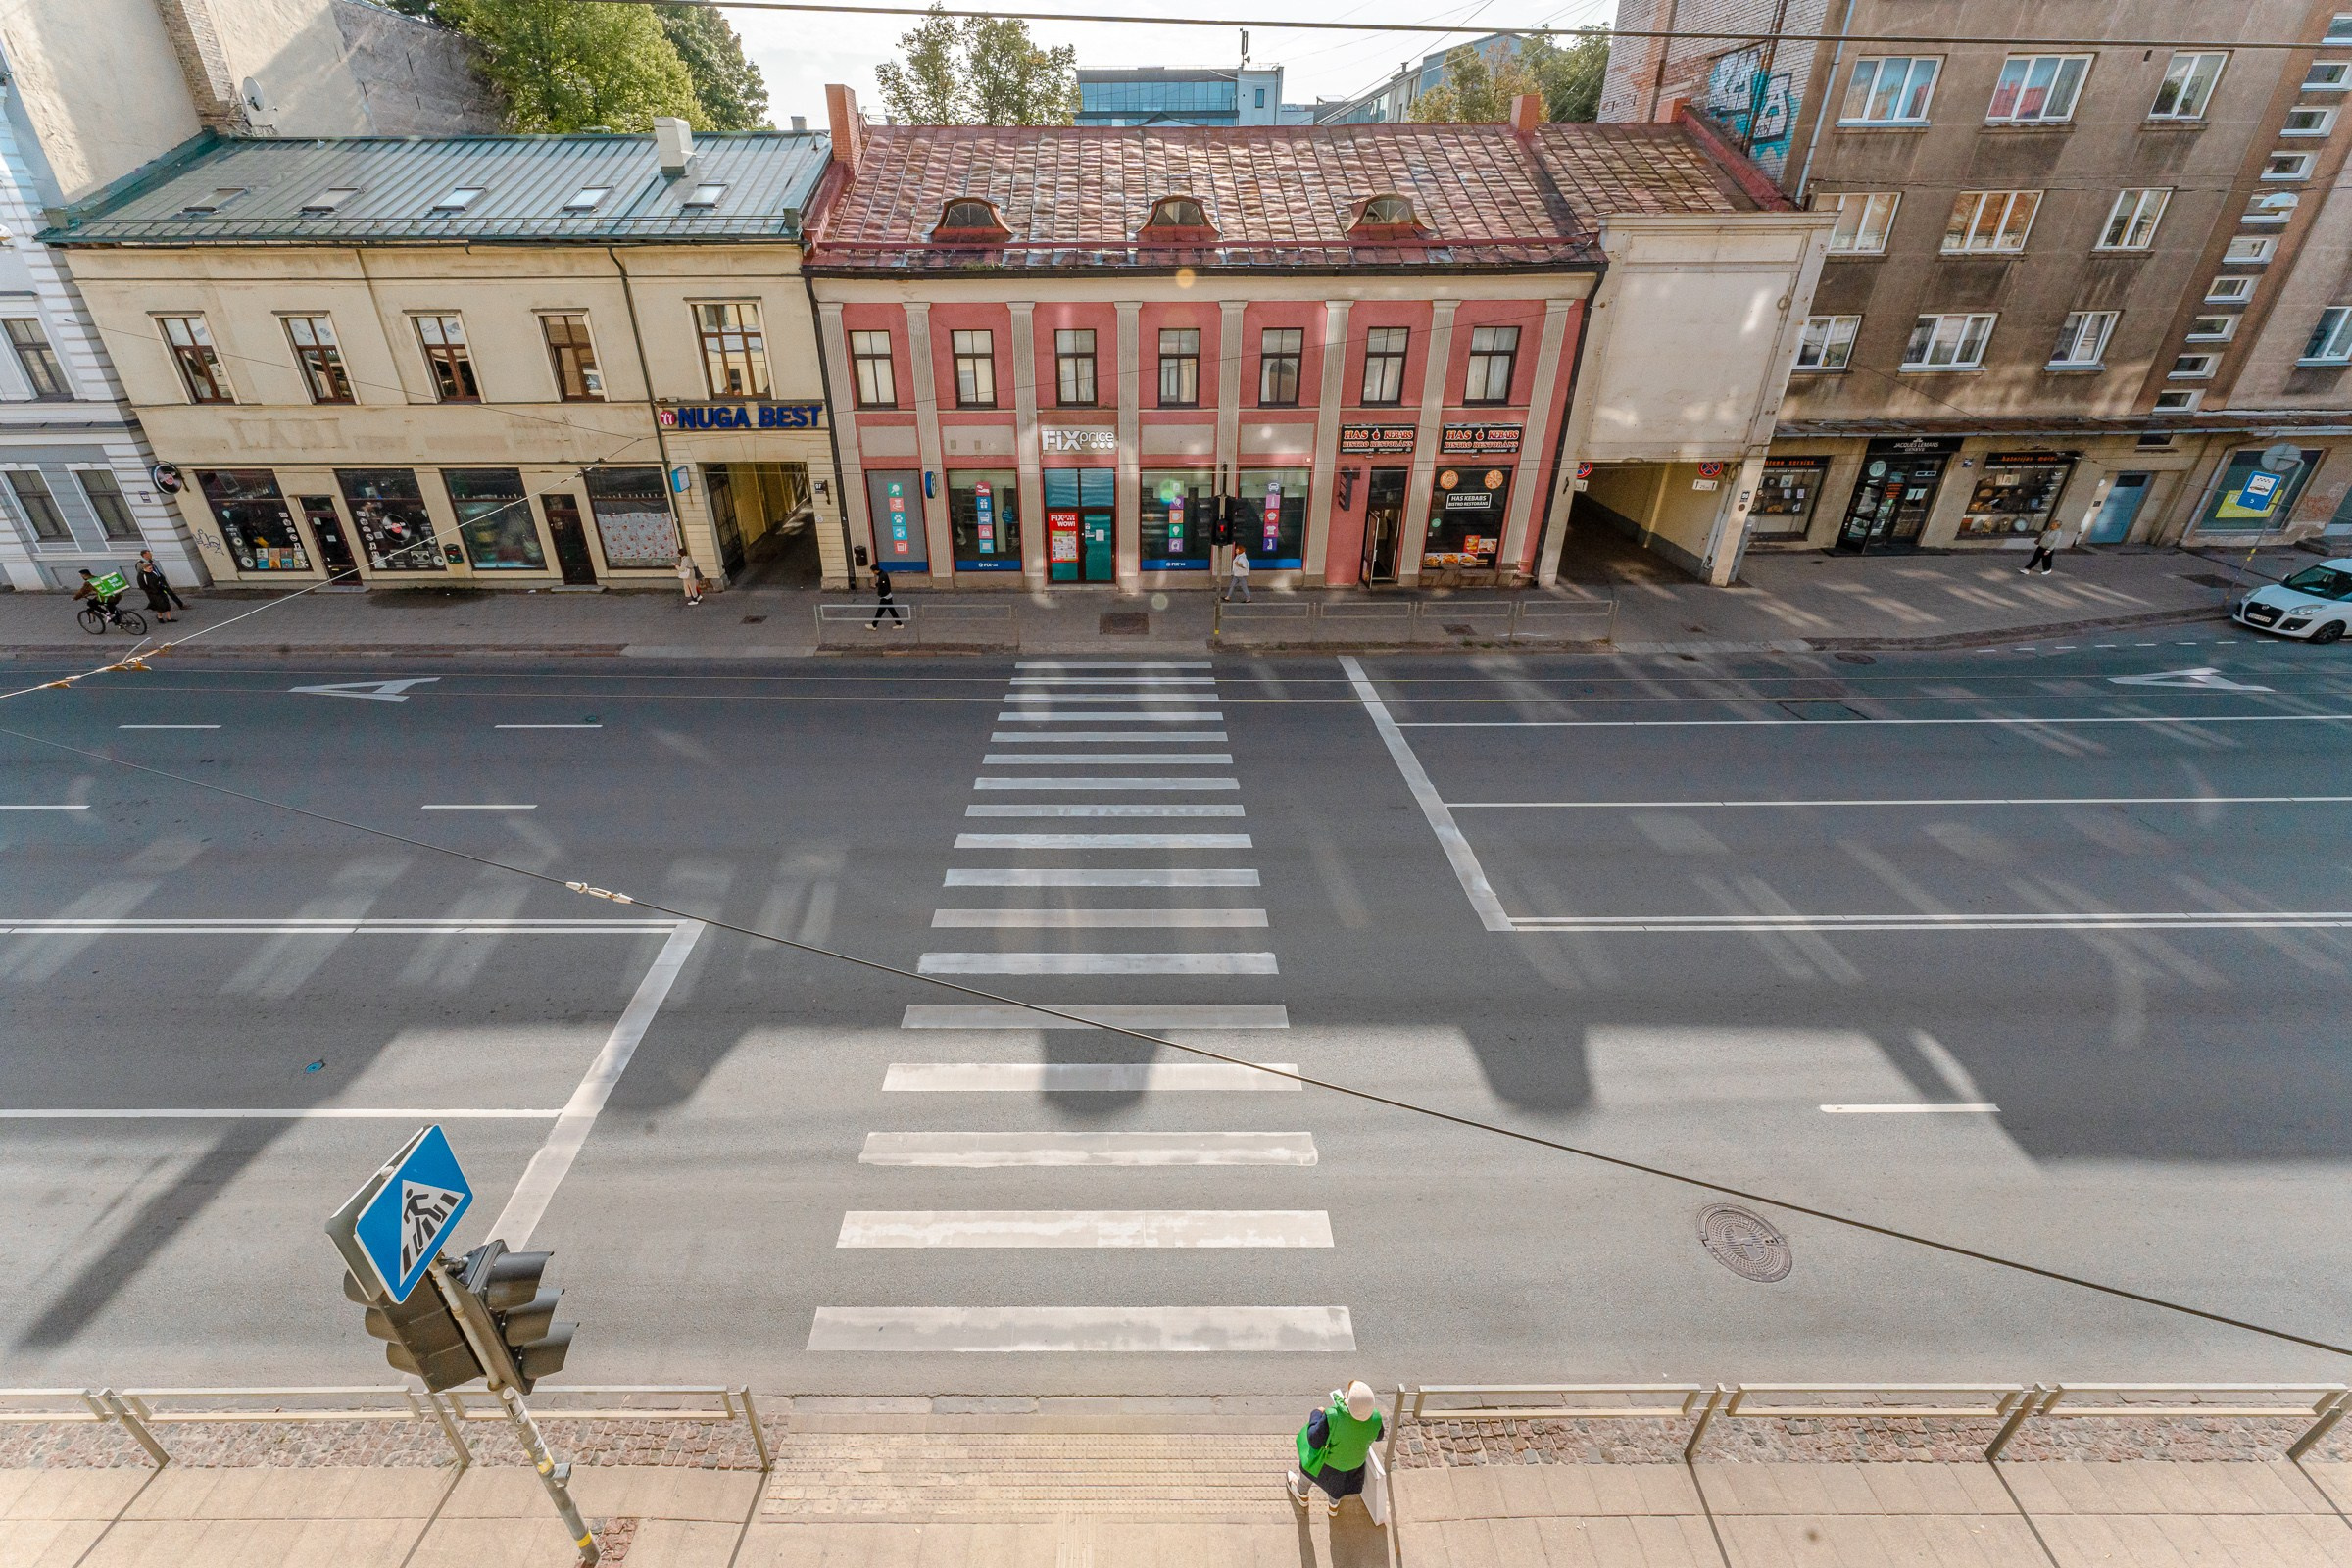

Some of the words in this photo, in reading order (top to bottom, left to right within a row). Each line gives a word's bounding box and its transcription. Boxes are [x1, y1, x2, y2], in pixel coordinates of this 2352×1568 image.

[677, 407, 752, 428] NUGA
[758, 406, 822, 428] BEST
[1080, 431, 1114, 444] price
[1344, 429, 1369, 440] HAS
[1384, 429, 1414, 440] KEBABS
[1446, 429, 1473, 440] HAS
[1488, 429, 1520, 440] KEBABS
